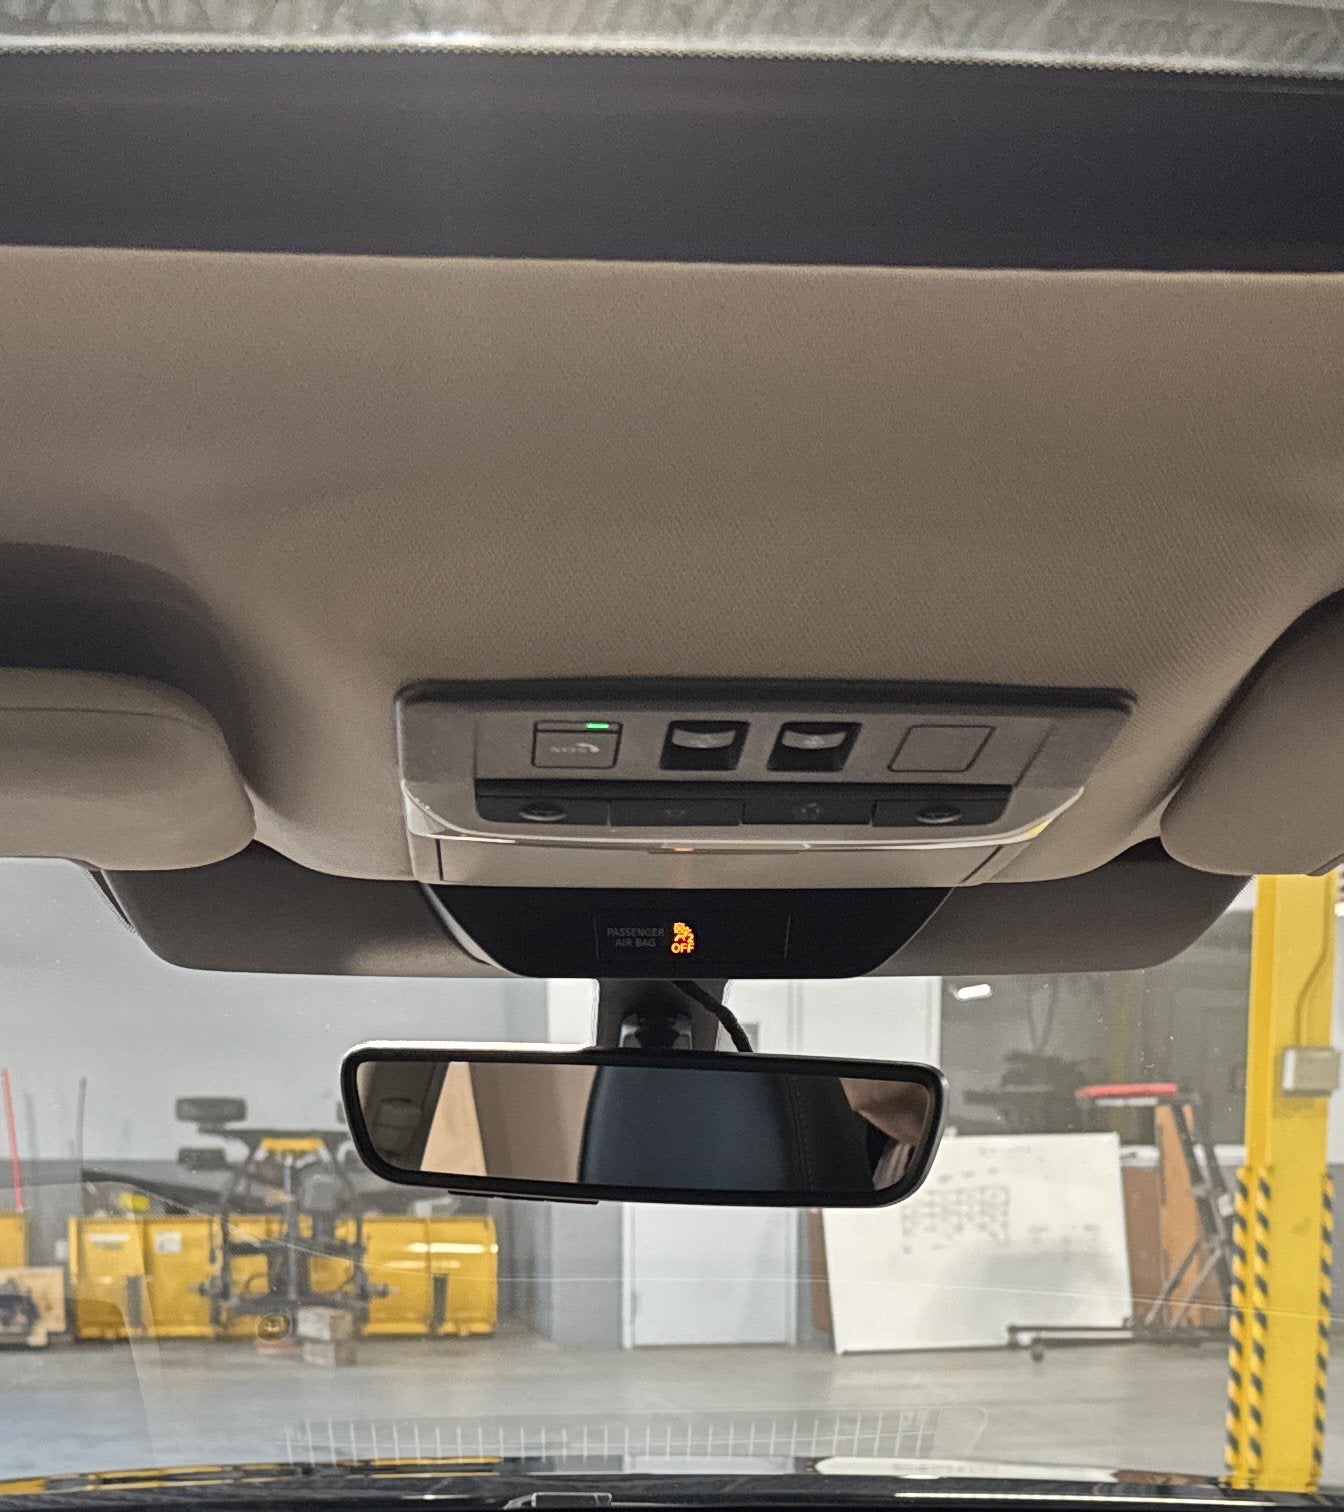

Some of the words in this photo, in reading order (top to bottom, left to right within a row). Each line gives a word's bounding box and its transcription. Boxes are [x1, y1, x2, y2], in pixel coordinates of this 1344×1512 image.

[607, 928, 665, 937] PASSENGER
[615, 938, 632, 947] AIR
[636, 938, 656, 947] BAG
[671, 943, 695, 953] OFF
